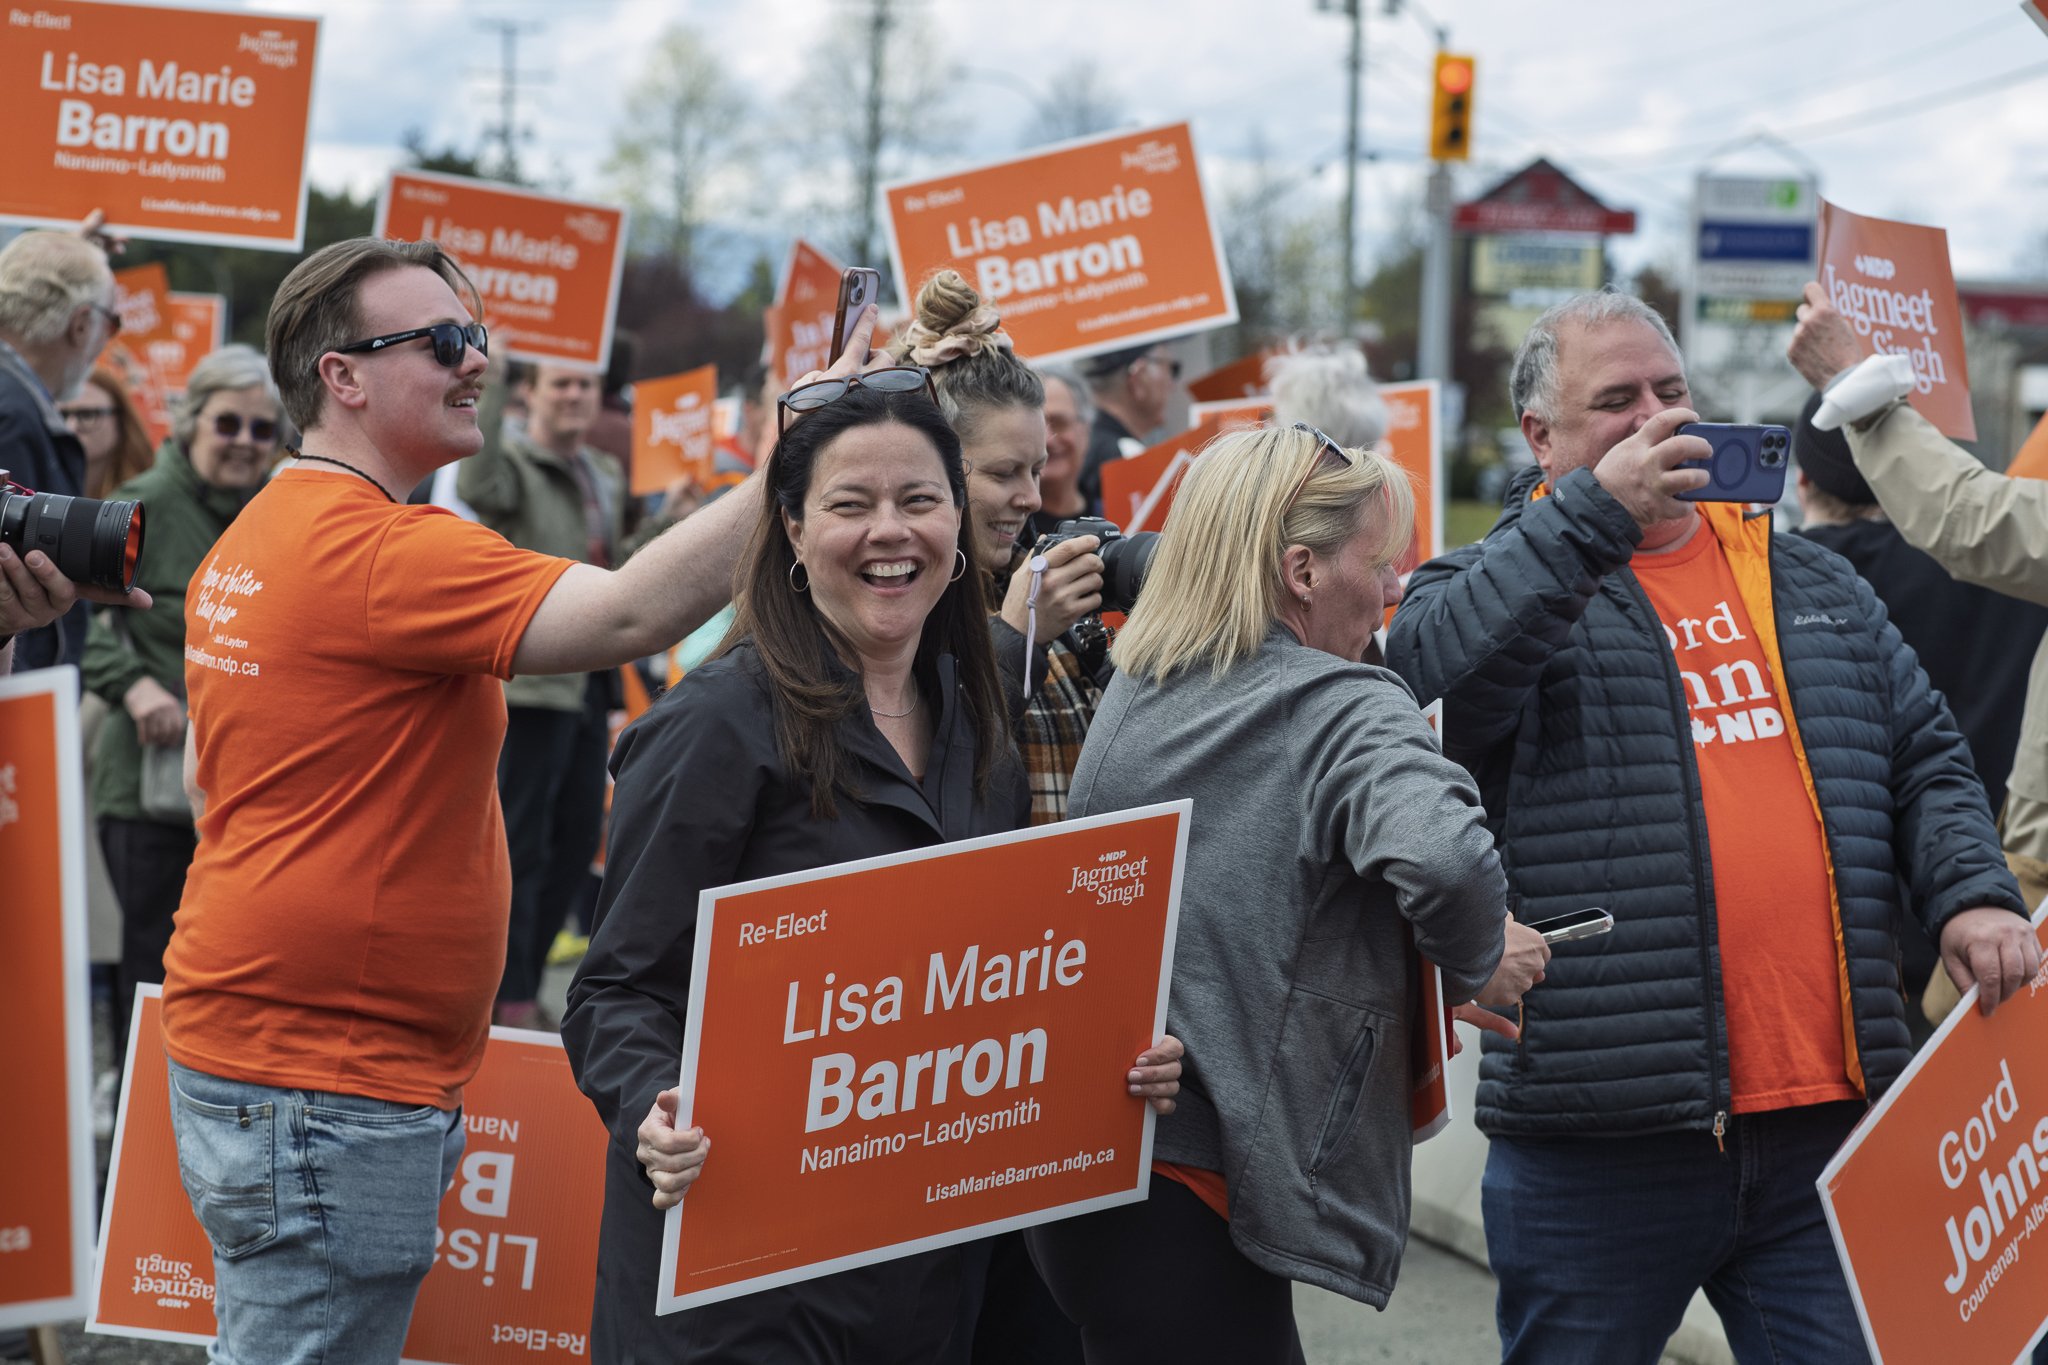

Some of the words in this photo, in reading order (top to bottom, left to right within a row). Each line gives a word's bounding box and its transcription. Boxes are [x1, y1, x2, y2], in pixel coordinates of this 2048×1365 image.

[10, 9, 71, 30] Re-Elect
[40, 51, 126, 96] Lisa
[136, 59, 256, 108] Marie
[56, 98, 229, 160] Barron
[947, 215, 1031, 259] Lisa
[1037, 184, 1152, 238] Marie
[491, 227, 578, 270] Marie
[975, 233, 1143, 300] Barron
[453, 262, 558, 305] arron
[1825, 263, 1938, 336] Jagmeet
[1872, 330, 1947, 394] Sigh
[225, 635, 248, 649] Layton
[1066, 855, 1148, 895] Jagmeet
[1105, 849, 1127, 863] NDP
[1096, 879, 1145, 907] Singh
[739, 909, 828, 947] Re-Elect
[783, 972, 904, 1045] Lisa
[923, 928, 1087, 1015] Marie
[804, 1026, 1048, 1134] Barron
[800, 1097, 1041, 1174] Nanaimo–Ladysmith
[1938, 1058, 2020, 1190] Gord
[925, 1146, 1115, 1203] LisaMarieBarron.ndp.ca
[132, 1276, 215, 1301] agmeet
[135, 1254, 192, 1281] Singh
[491, 1324, 586, 1355] Re-Elect
